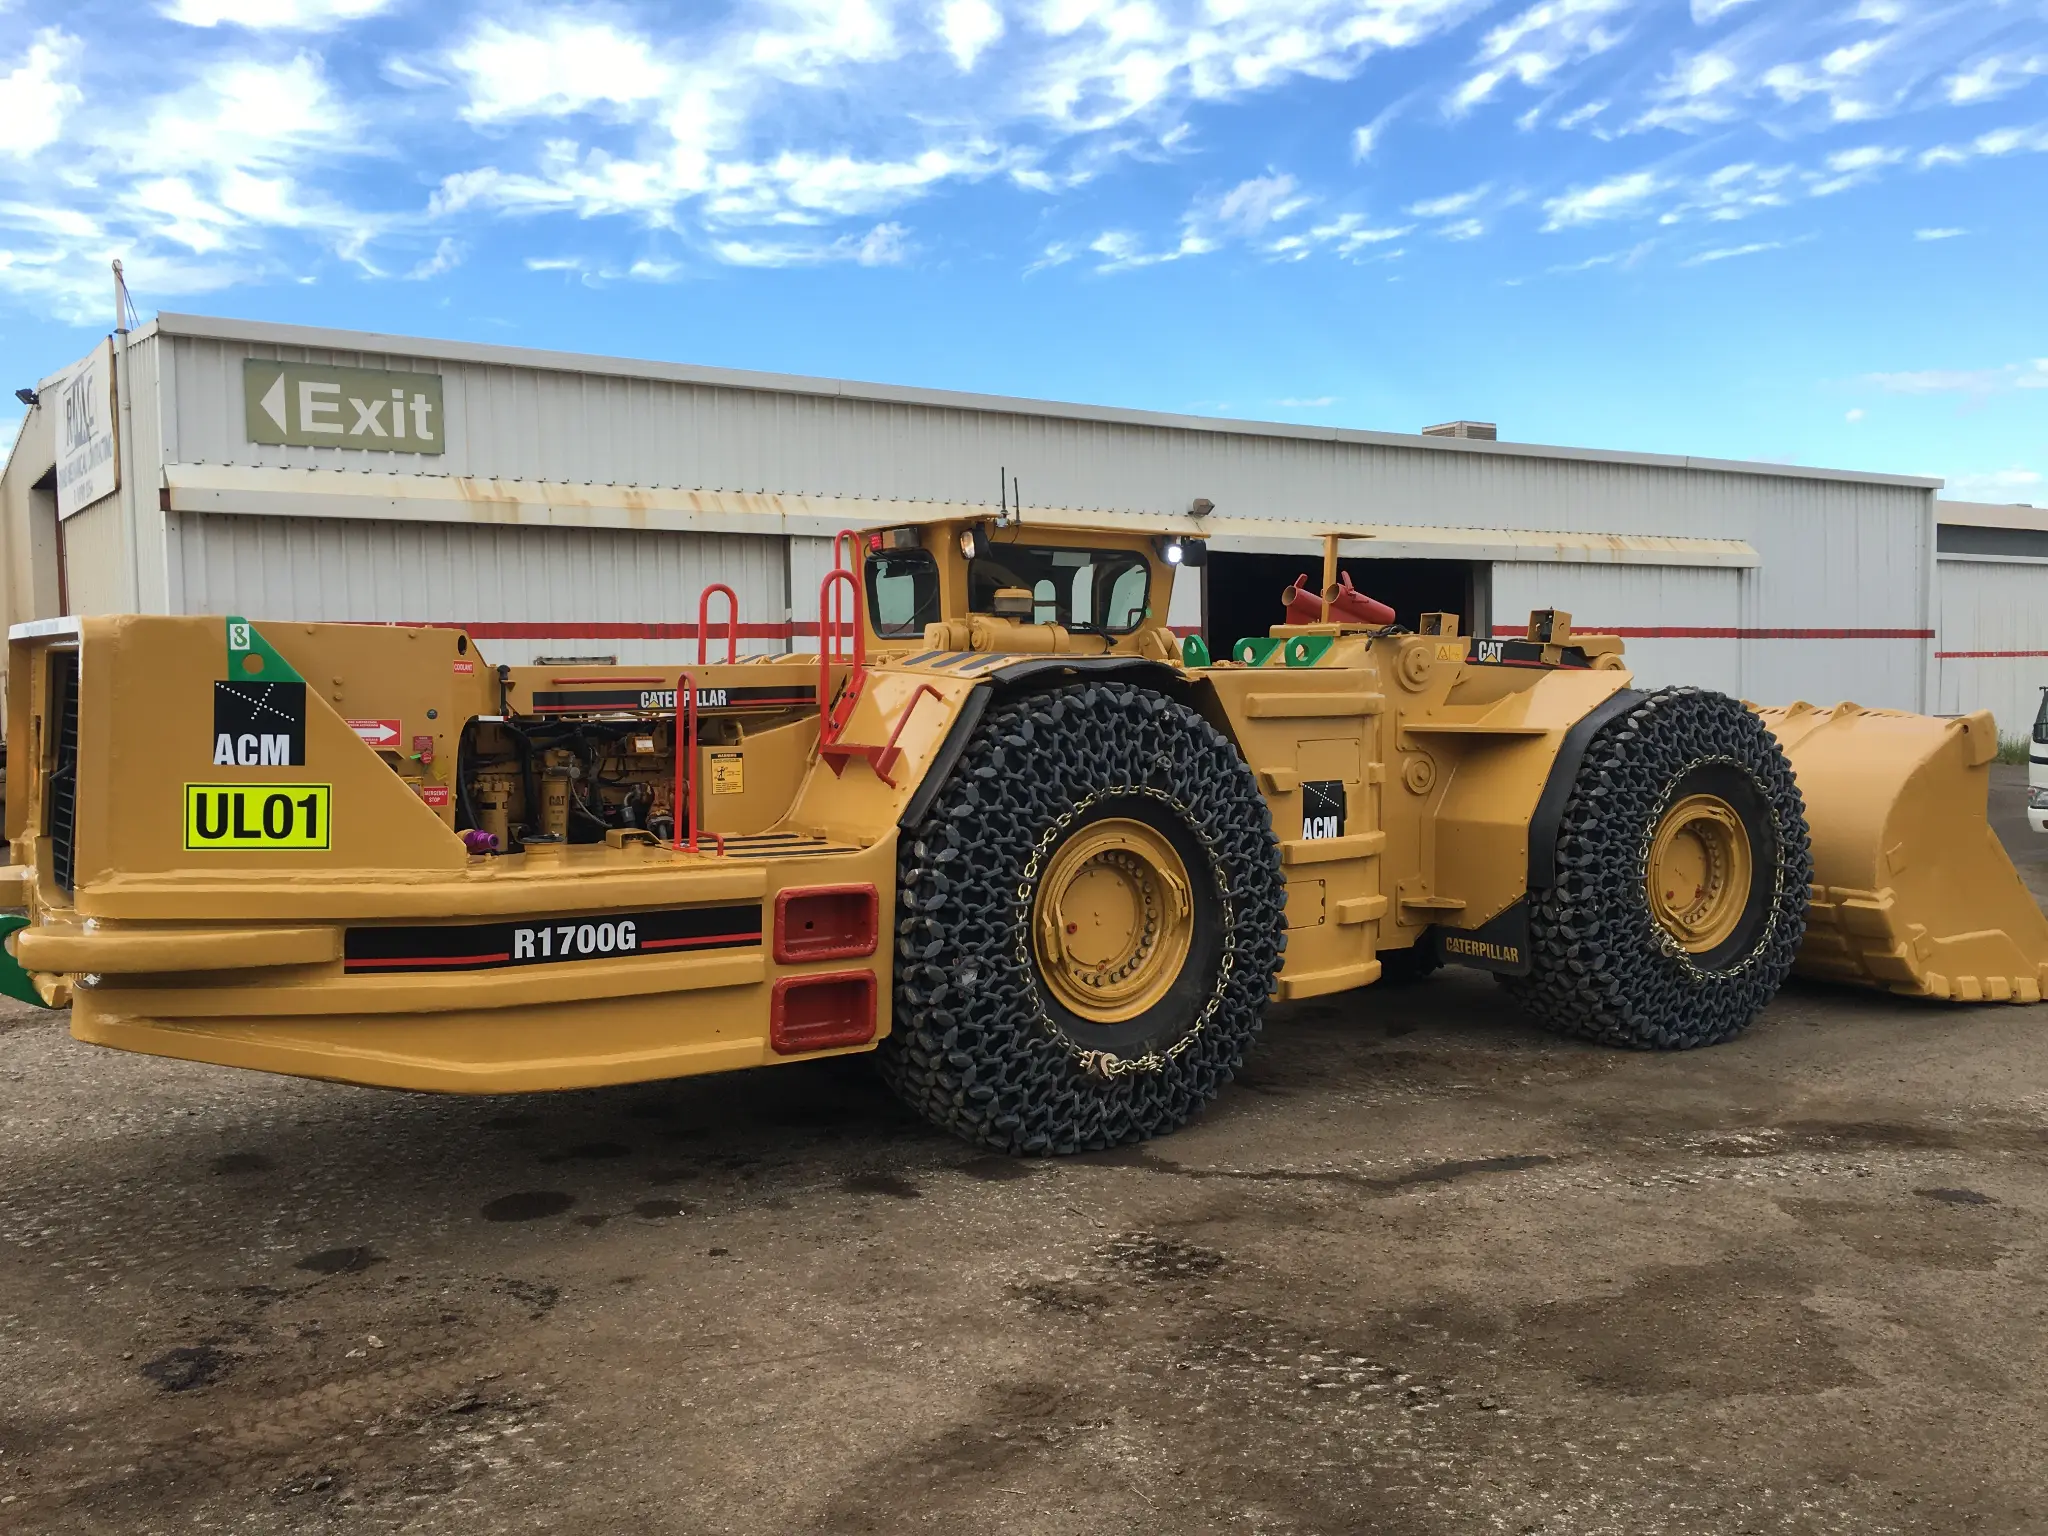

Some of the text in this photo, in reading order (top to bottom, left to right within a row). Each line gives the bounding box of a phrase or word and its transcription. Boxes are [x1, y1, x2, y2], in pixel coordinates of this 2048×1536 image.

[298, 381, 434, 440] Exit
[1478, 640, 1504, 663] CAT
[640, 689, 727, 708] CATEPLLAR
[213, 733, 290, 766] ACM
[196, 792, 317, 839] UL01
[1302, 815, 1338, 840] ACM
[514, 920, 636, 959] R1700G
[1446, 936, 1519, 963] CATERPILLAR
